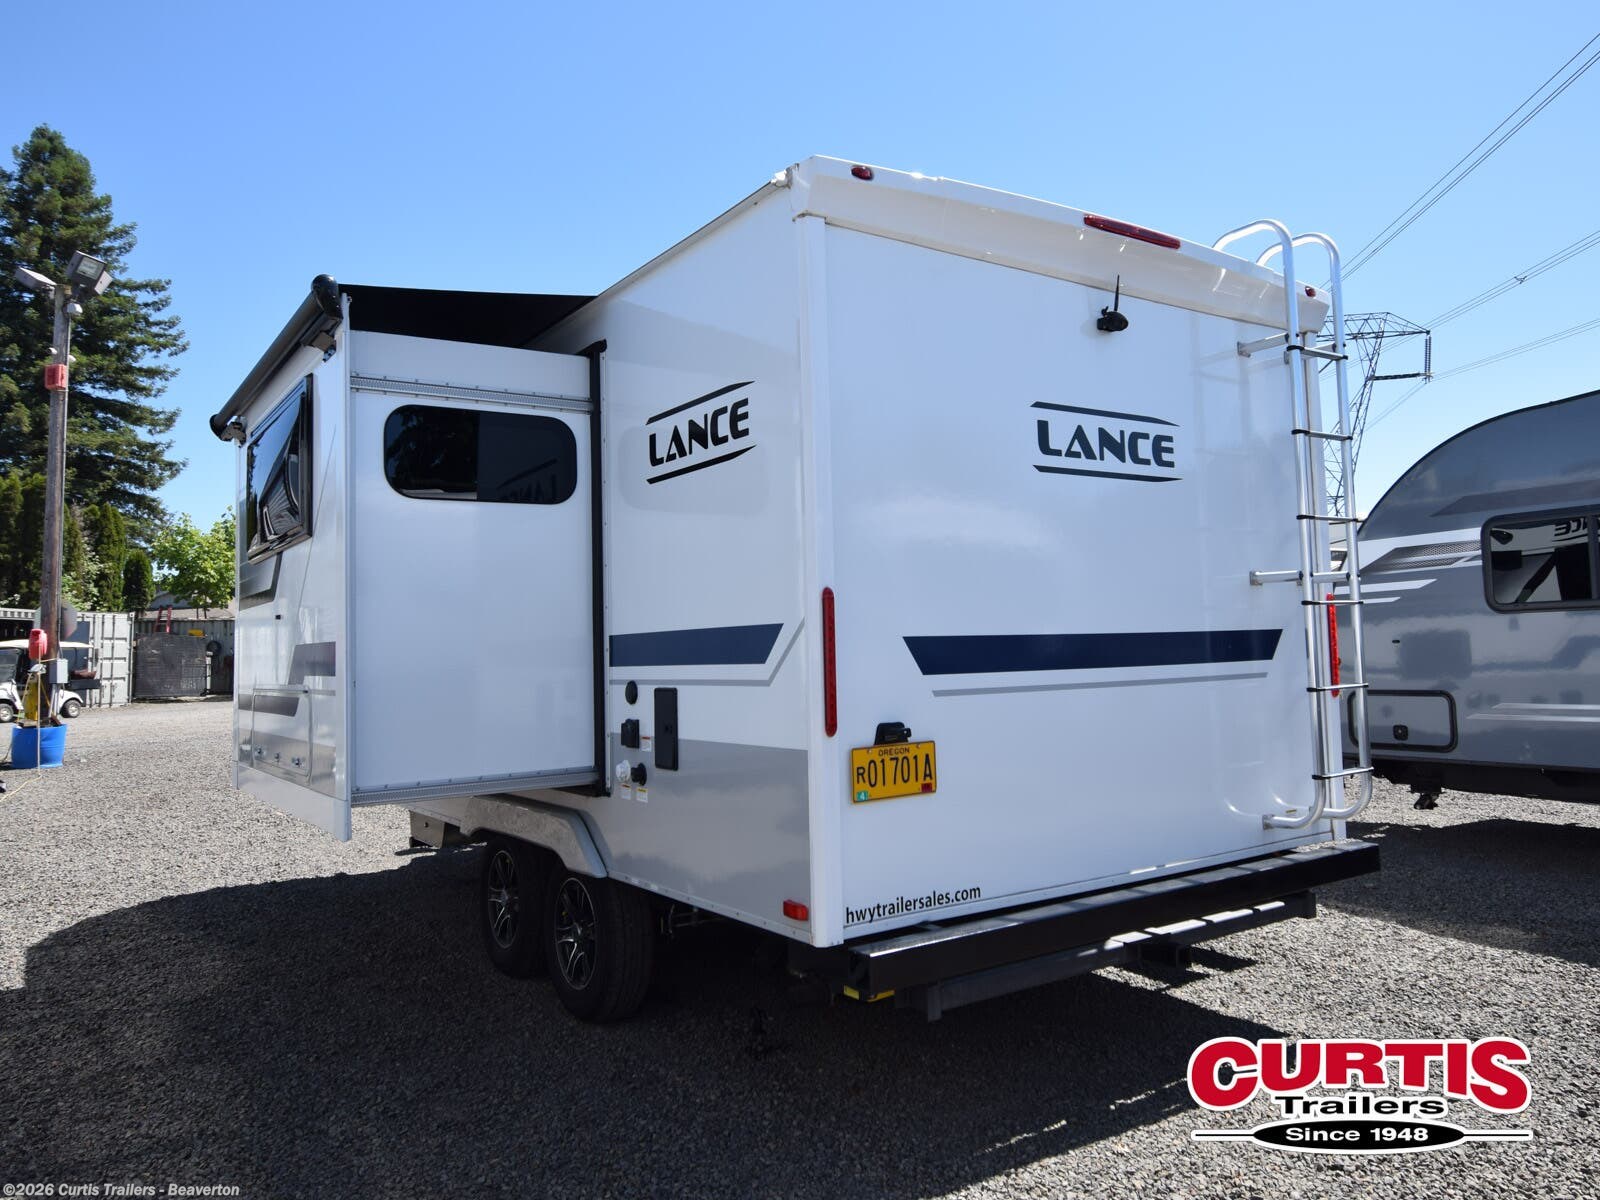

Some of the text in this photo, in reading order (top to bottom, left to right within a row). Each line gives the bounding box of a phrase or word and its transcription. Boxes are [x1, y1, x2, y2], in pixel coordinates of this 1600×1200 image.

[649, 397, 749, 467] LANCE
[1037, 419, 1175, 468] LANCE
[856, 753, 933, 788] R01701A
[878, 747, 910, 757] OREGON
[846, 886, 981, 923] hwytrailersales.com
